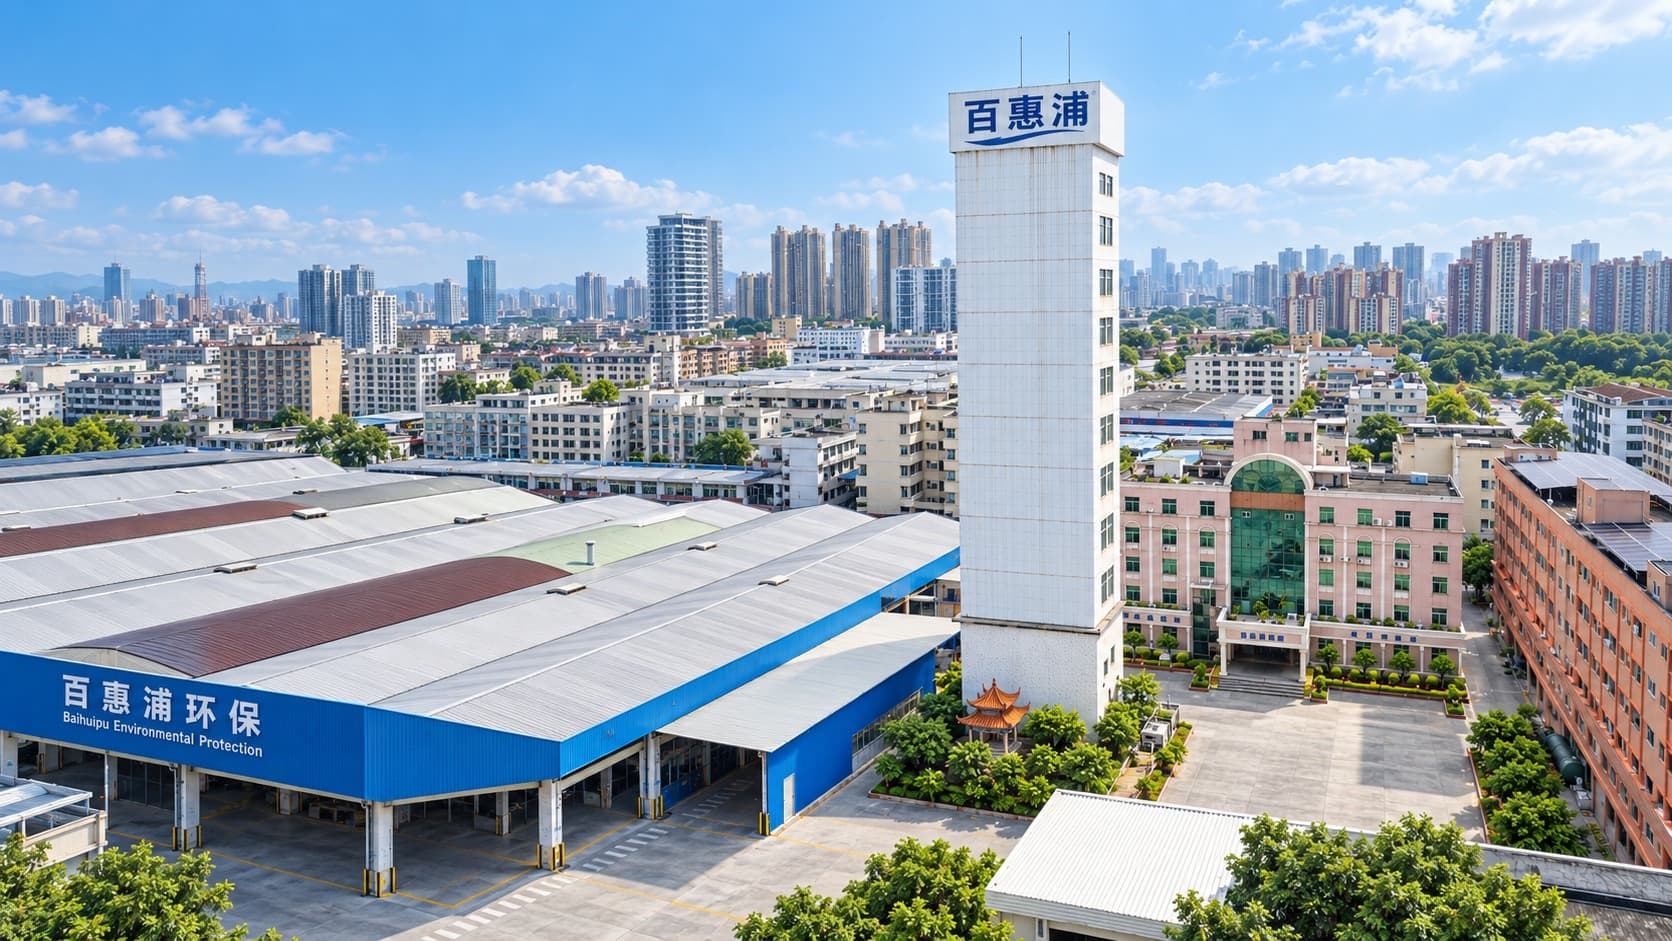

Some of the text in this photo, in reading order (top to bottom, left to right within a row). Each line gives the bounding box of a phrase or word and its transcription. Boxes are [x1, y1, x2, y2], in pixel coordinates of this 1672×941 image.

[964, 91, 1089, 134] 百惠浦
[62, 674, 261, 737] 百惠浦环保
[63, 711, 263, 758] Baihuipu Environmental Protection
